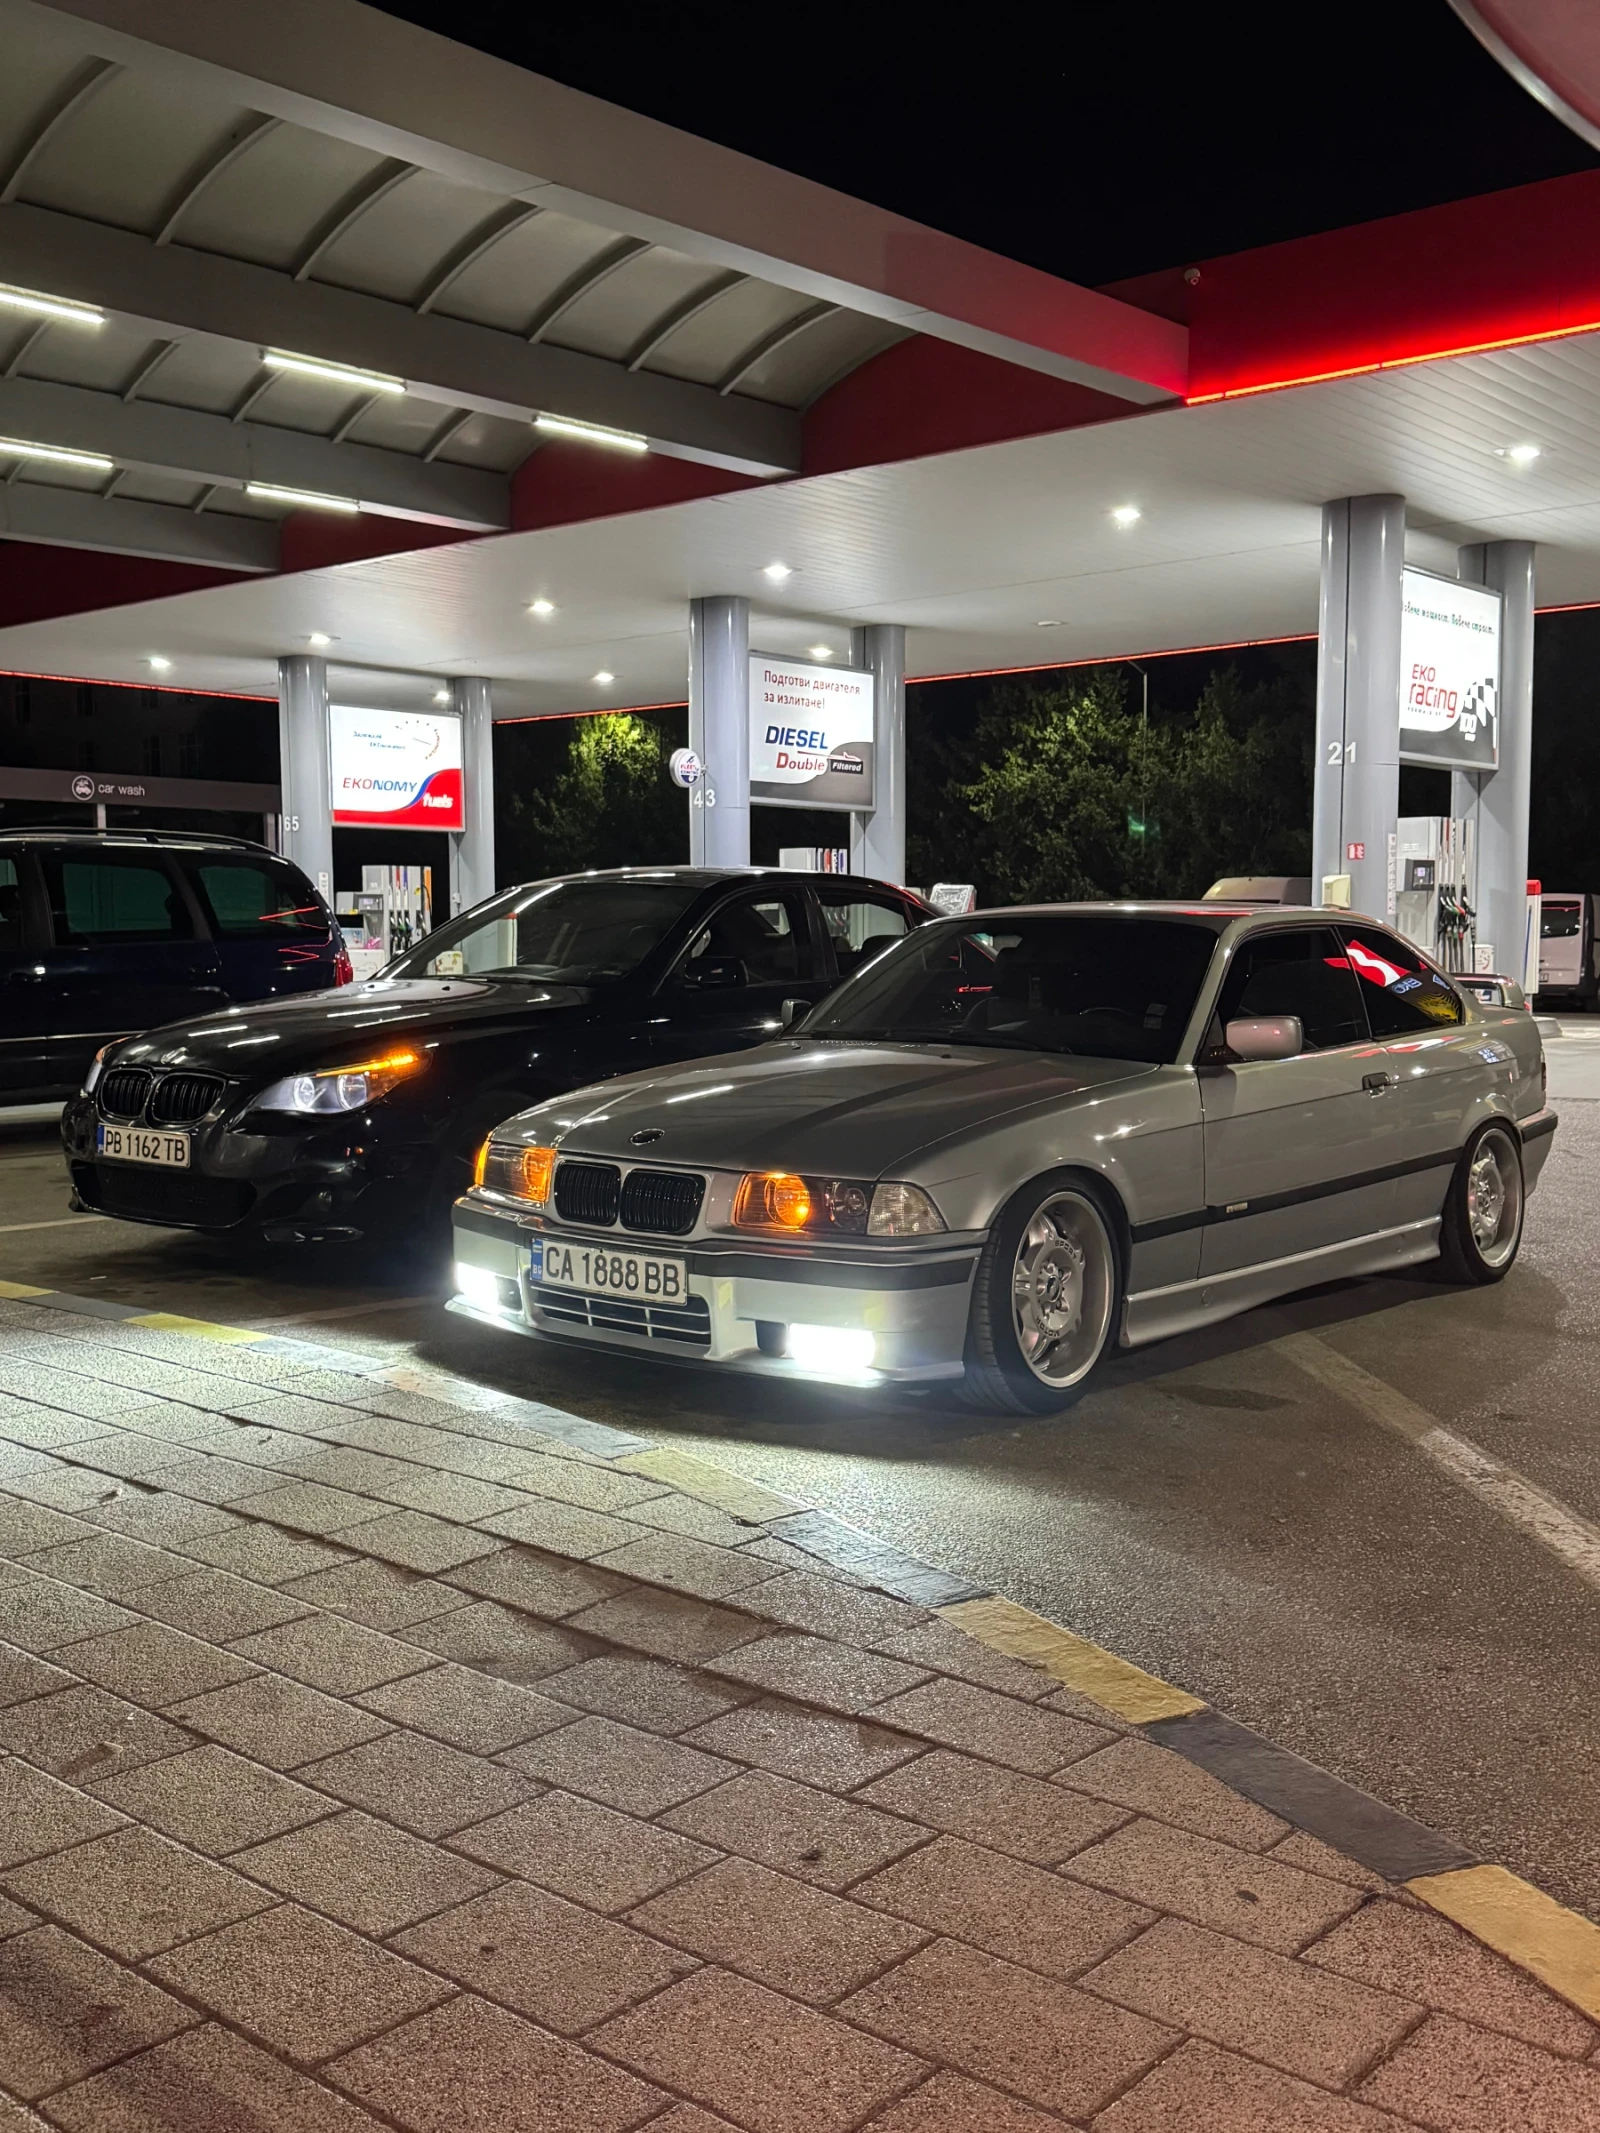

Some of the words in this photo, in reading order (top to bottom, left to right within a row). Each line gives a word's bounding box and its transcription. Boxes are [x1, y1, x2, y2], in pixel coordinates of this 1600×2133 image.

[1411, 663, 1436, 682] EKO
[764, 670, 811, 688] Подготви
[812, 679, 861, 695] двигателя
[763, 692, 775, 703] за
[777, 693, 826, 710] излитане!
[1408, 683, 1458, 719] racing
[765, 725, 828, 750] DIESEL
[776, 752, 825, 771] Double
[1327, 741, 1357, 765] 21
[98, 784, 115, 794] car
[117, 785, 146, 797] wash
[342, 777, 418, 793] EKONOMY
[422, 792, 454, 809] fuels
[693, 788, 716, 808] 43
[284, 815, 300, 832] 65
[105, 1130, 122, 1154] PB
[126, 1133, 161, 1160] 1162
[163, 1137, 185, 1162] TB
[545, 1246, 574, 1282] CA
[581, 1252, 640, 1291] 1888
[644, 1261, 680, 1297] BB
